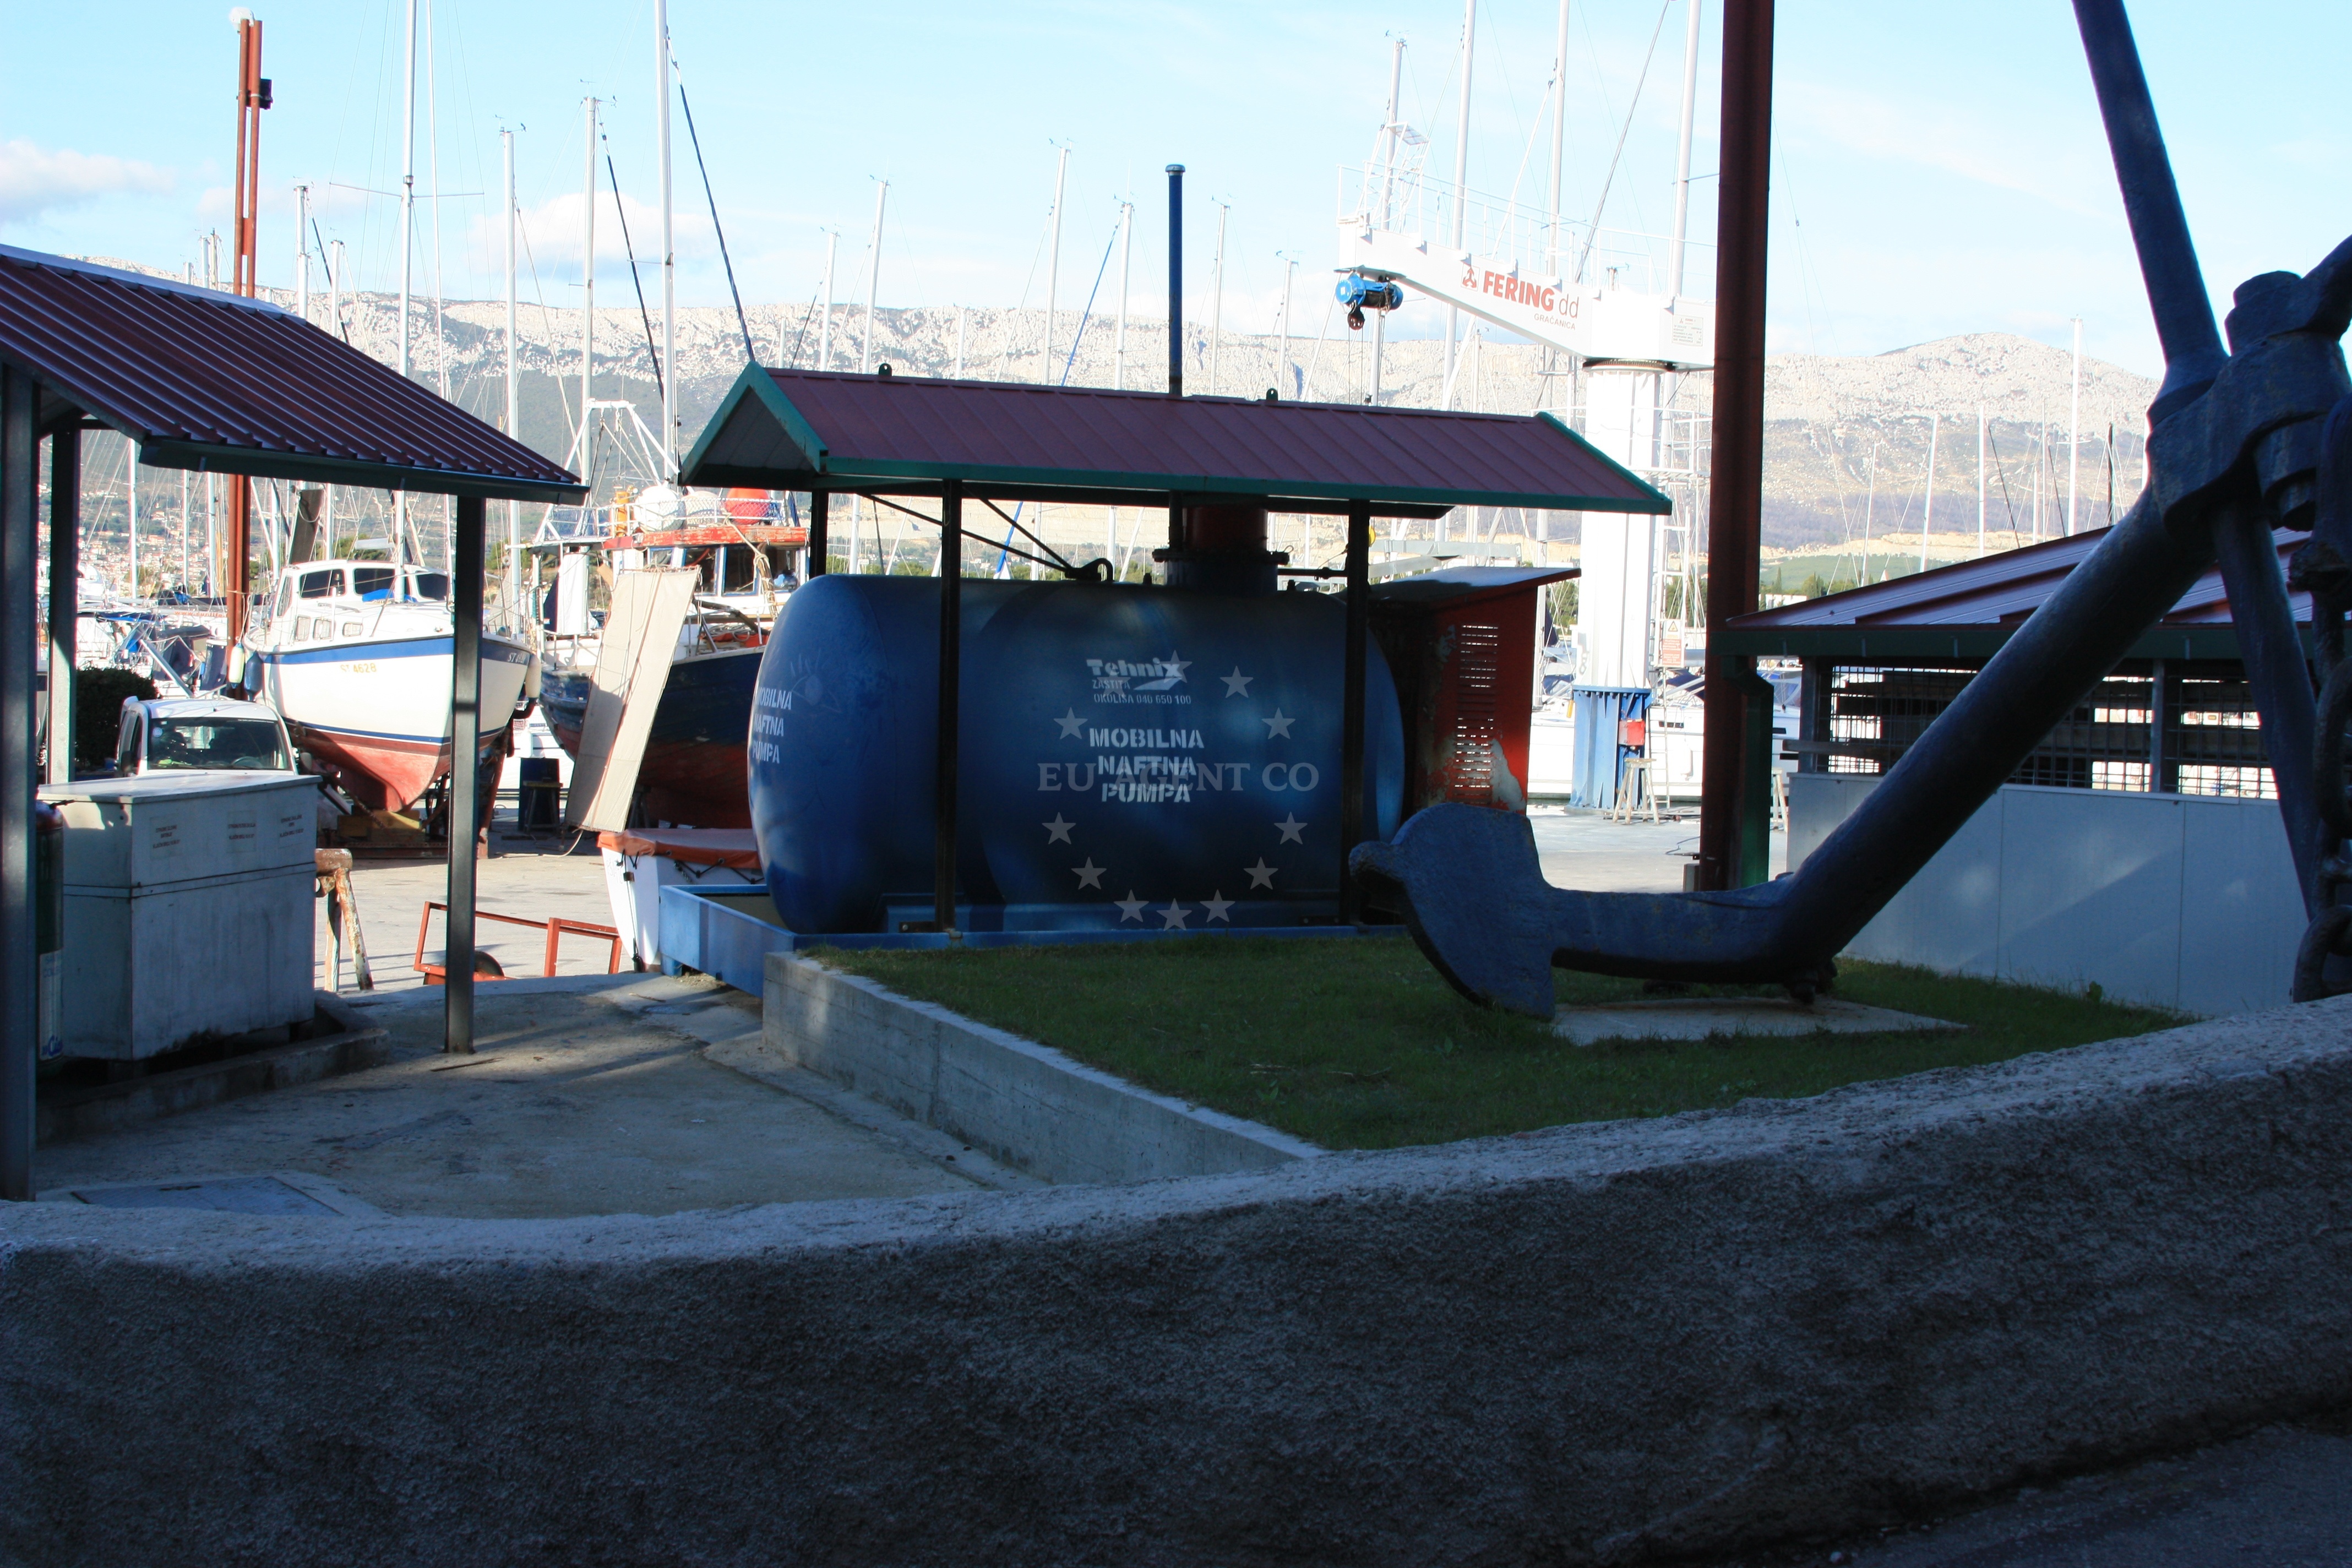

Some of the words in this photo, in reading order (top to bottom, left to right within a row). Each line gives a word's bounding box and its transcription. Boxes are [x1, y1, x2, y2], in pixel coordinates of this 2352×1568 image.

[1483, 270, 1555, 312] FERING
[1559, 293, 1579, 319] dd
[1534, 313, 1576, 330] GRAČANICA
[353, 663, 377, 673] 4628
[1086, 657, 1183, 677] Tehnix
[755, 687, 792, 710] OBILNA
[1137, 694, 1153, 704] 040
[1156, 694, 1172, 704] 650
[1175, 695, 1191, 704] 100
[754, 714, 784, 736] NAFTNA
[1089, 728, 1204, 748] MOBILNA
[752, 740, 780, 764] PUMPA
[1098, 755, 1196, 775] NAFTNA
[1102, 783, 1190, 802] PUMPA
